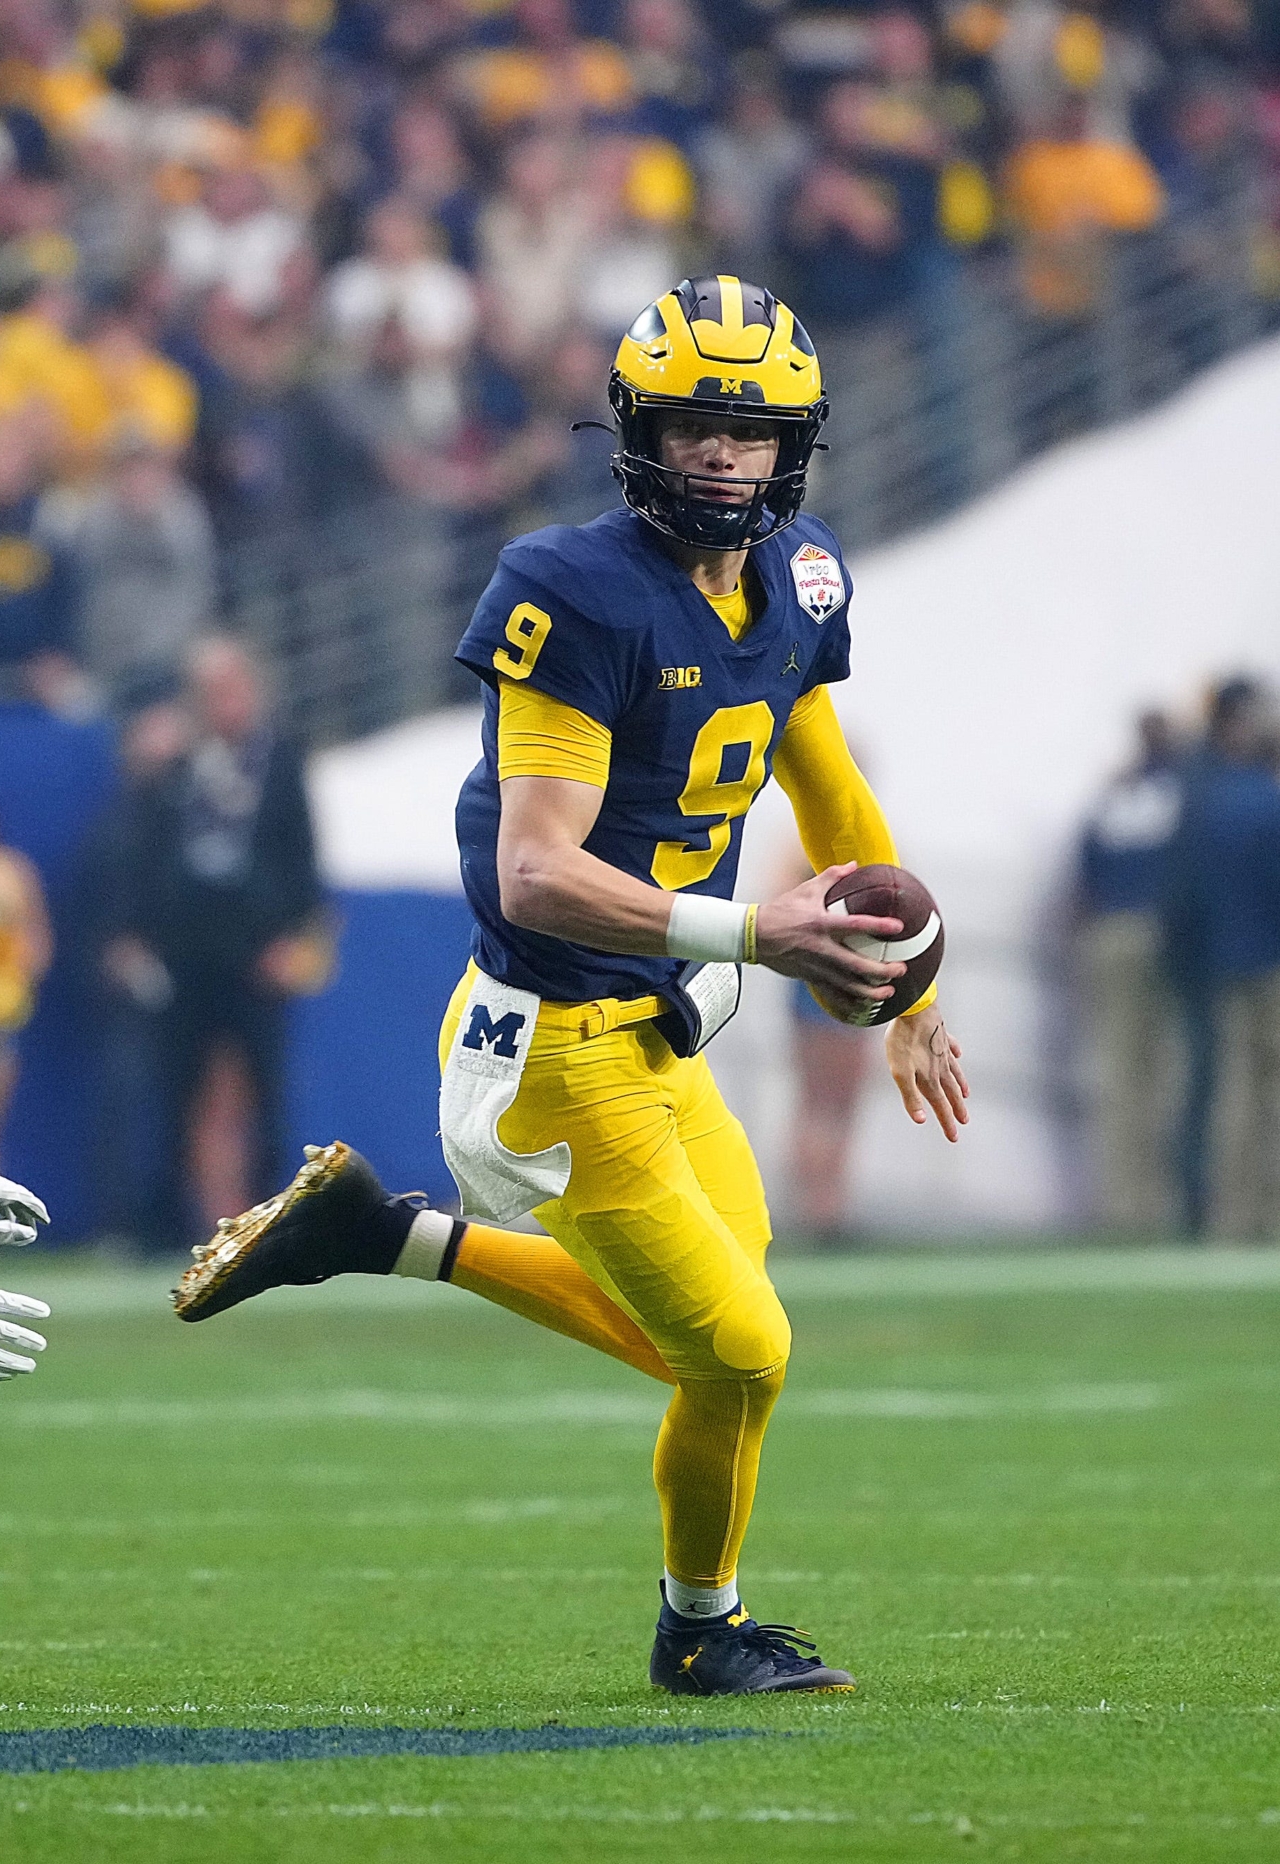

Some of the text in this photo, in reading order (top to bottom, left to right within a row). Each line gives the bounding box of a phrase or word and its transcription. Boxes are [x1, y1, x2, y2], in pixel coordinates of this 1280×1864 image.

[719, 378, 743, 395] M
[492, 601, 553, 681] 9
[649, 700, 775, 892] 9
[461, 1004, 526, 1059] M
